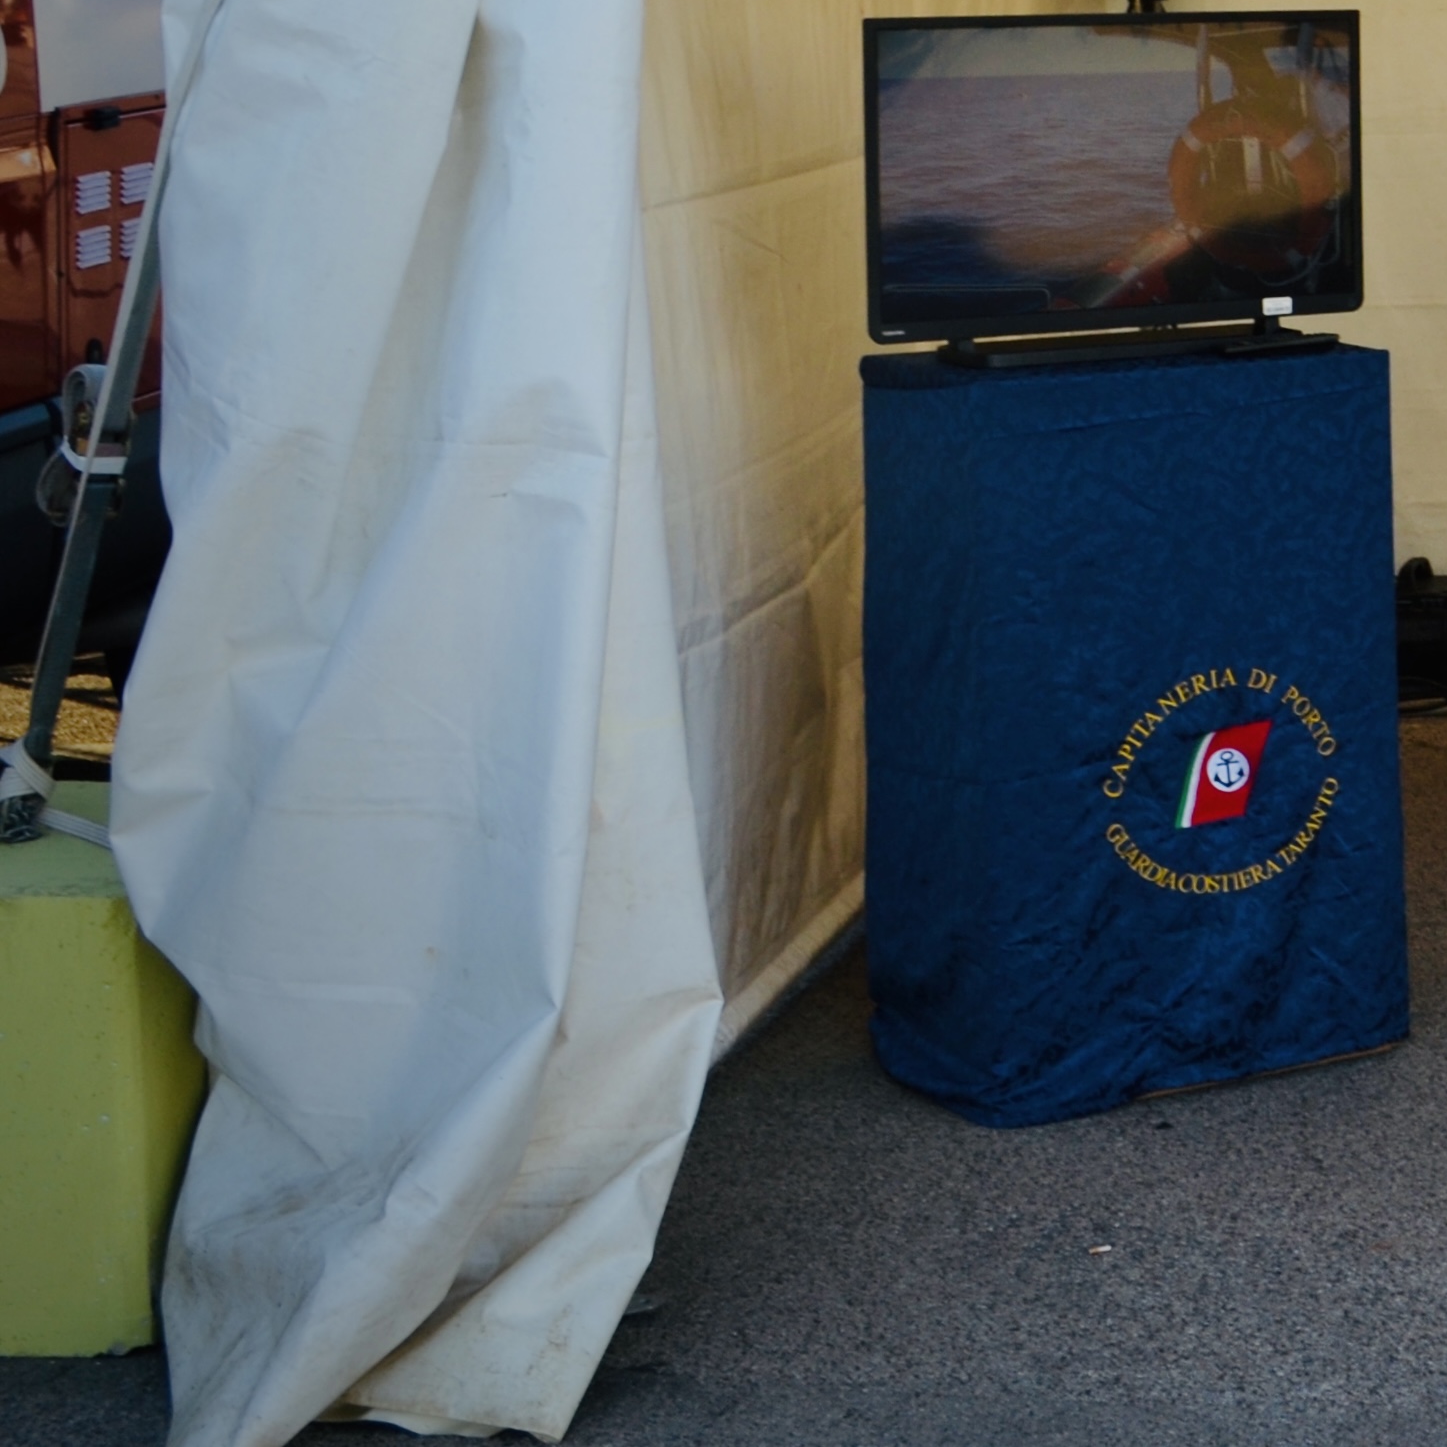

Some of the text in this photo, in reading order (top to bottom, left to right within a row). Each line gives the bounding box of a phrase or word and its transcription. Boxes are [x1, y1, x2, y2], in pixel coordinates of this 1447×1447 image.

[1102, 667, 1337, 798] CAPITANERIA DI PORTO
[1275, 776, 1340, 867] TARANTO
